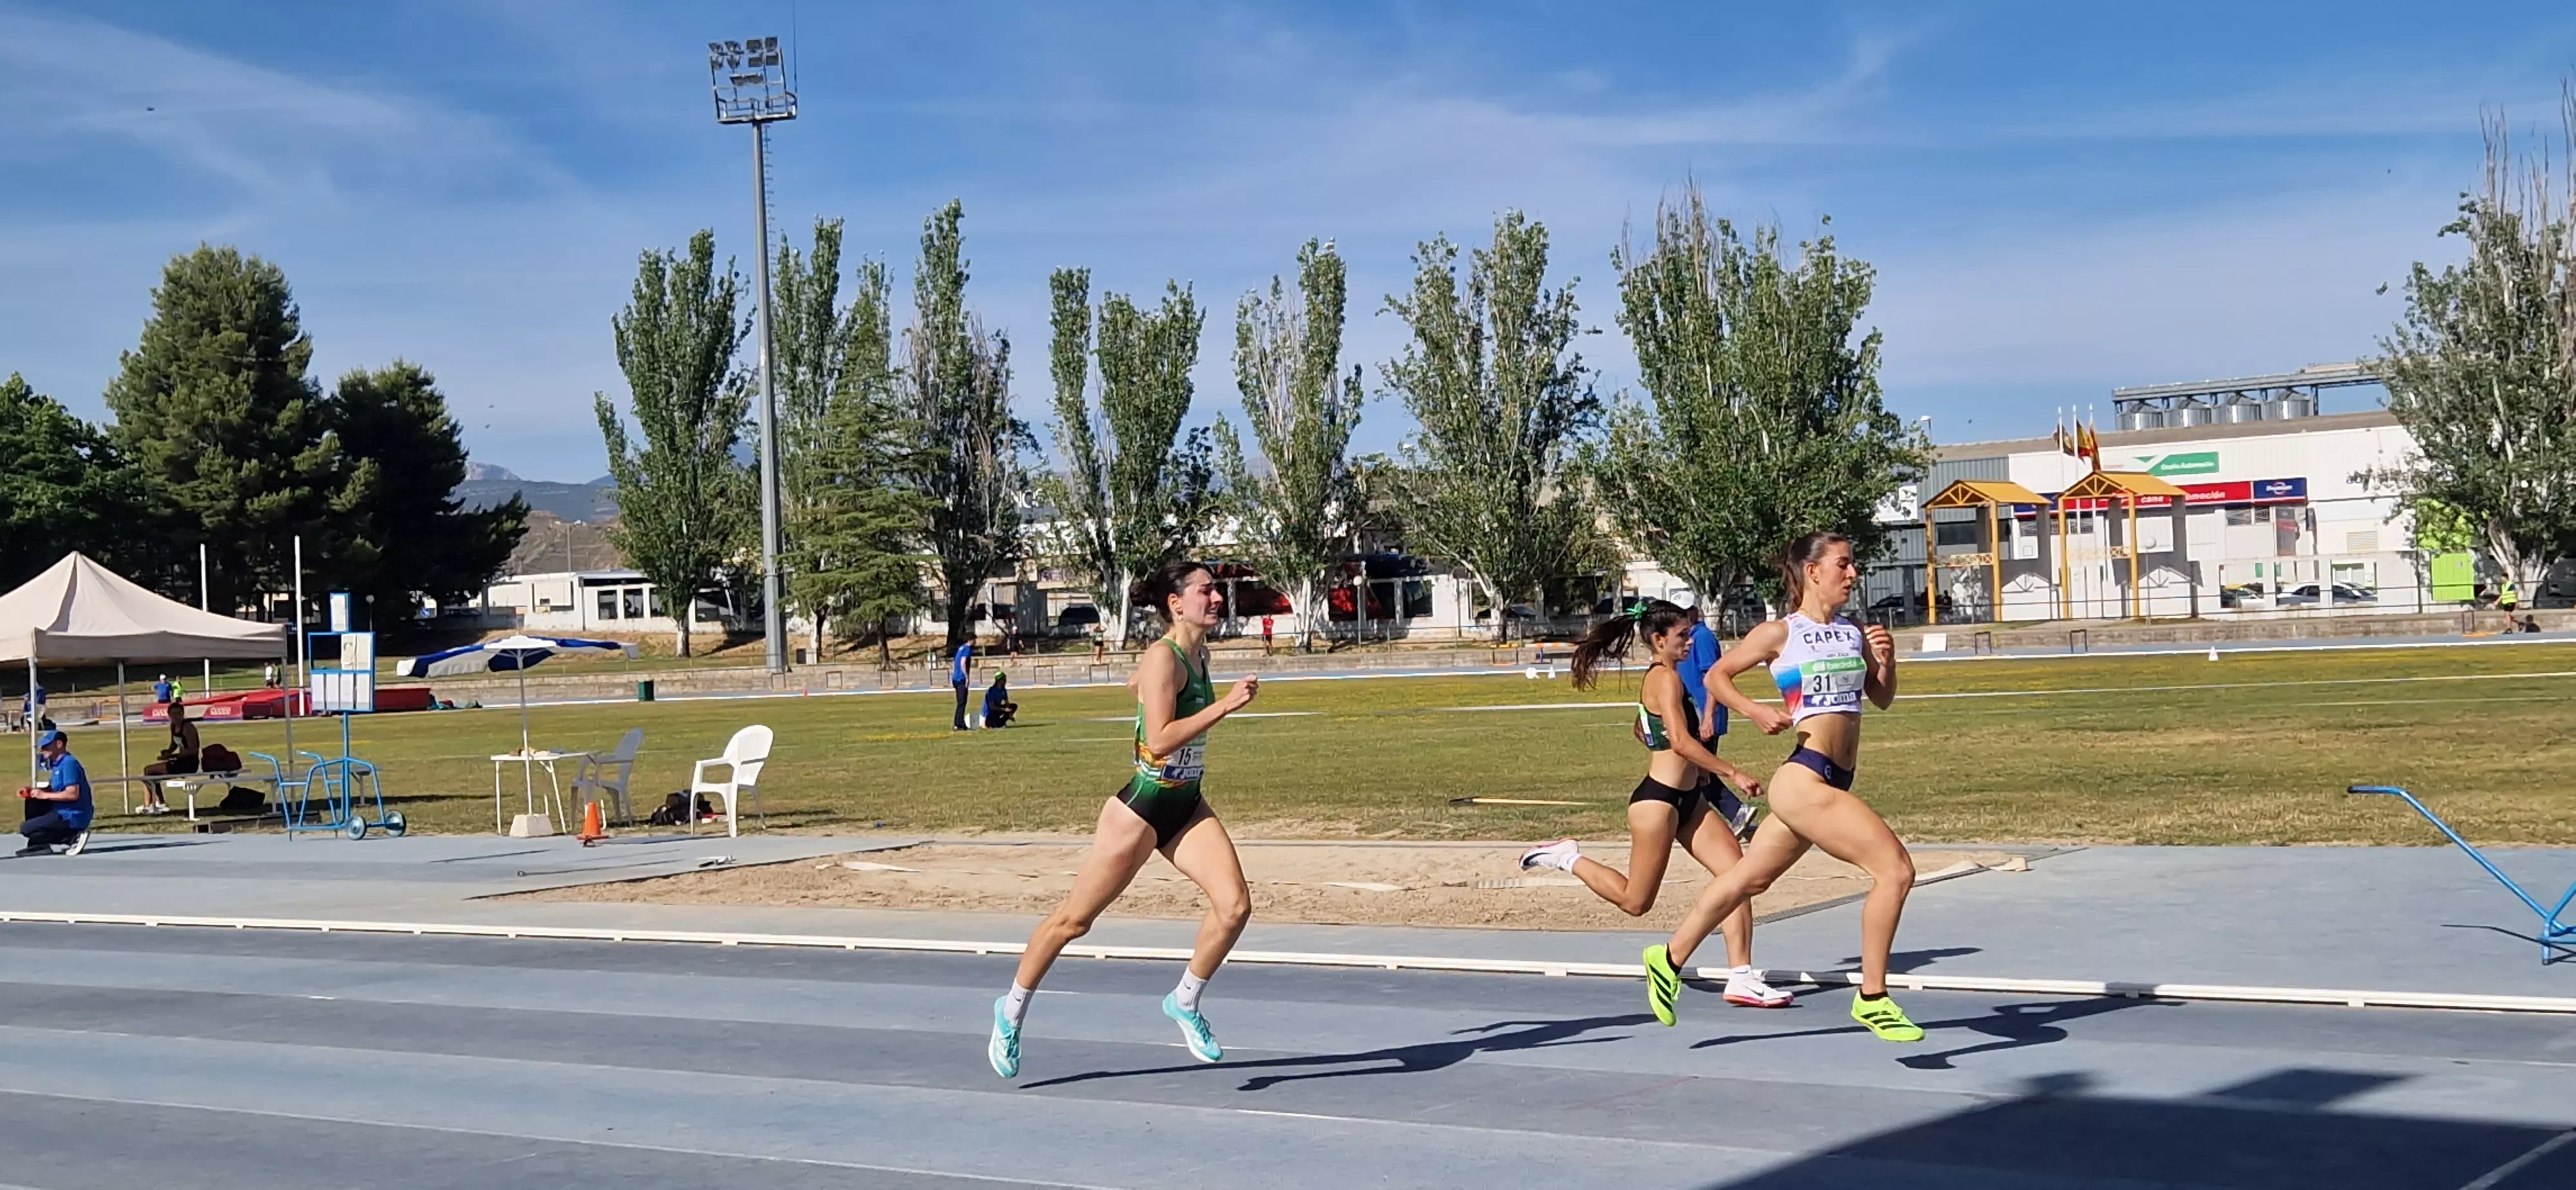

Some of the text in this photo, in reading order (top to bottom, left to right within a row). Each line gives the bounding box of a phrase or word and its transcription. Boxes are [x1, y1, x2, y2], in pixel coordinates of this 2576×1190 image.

[1803, 630, 1855, 645] CAPEX
[1813, 674, 1831, 693] 31
[1178, 748, 1193, 766] 15
